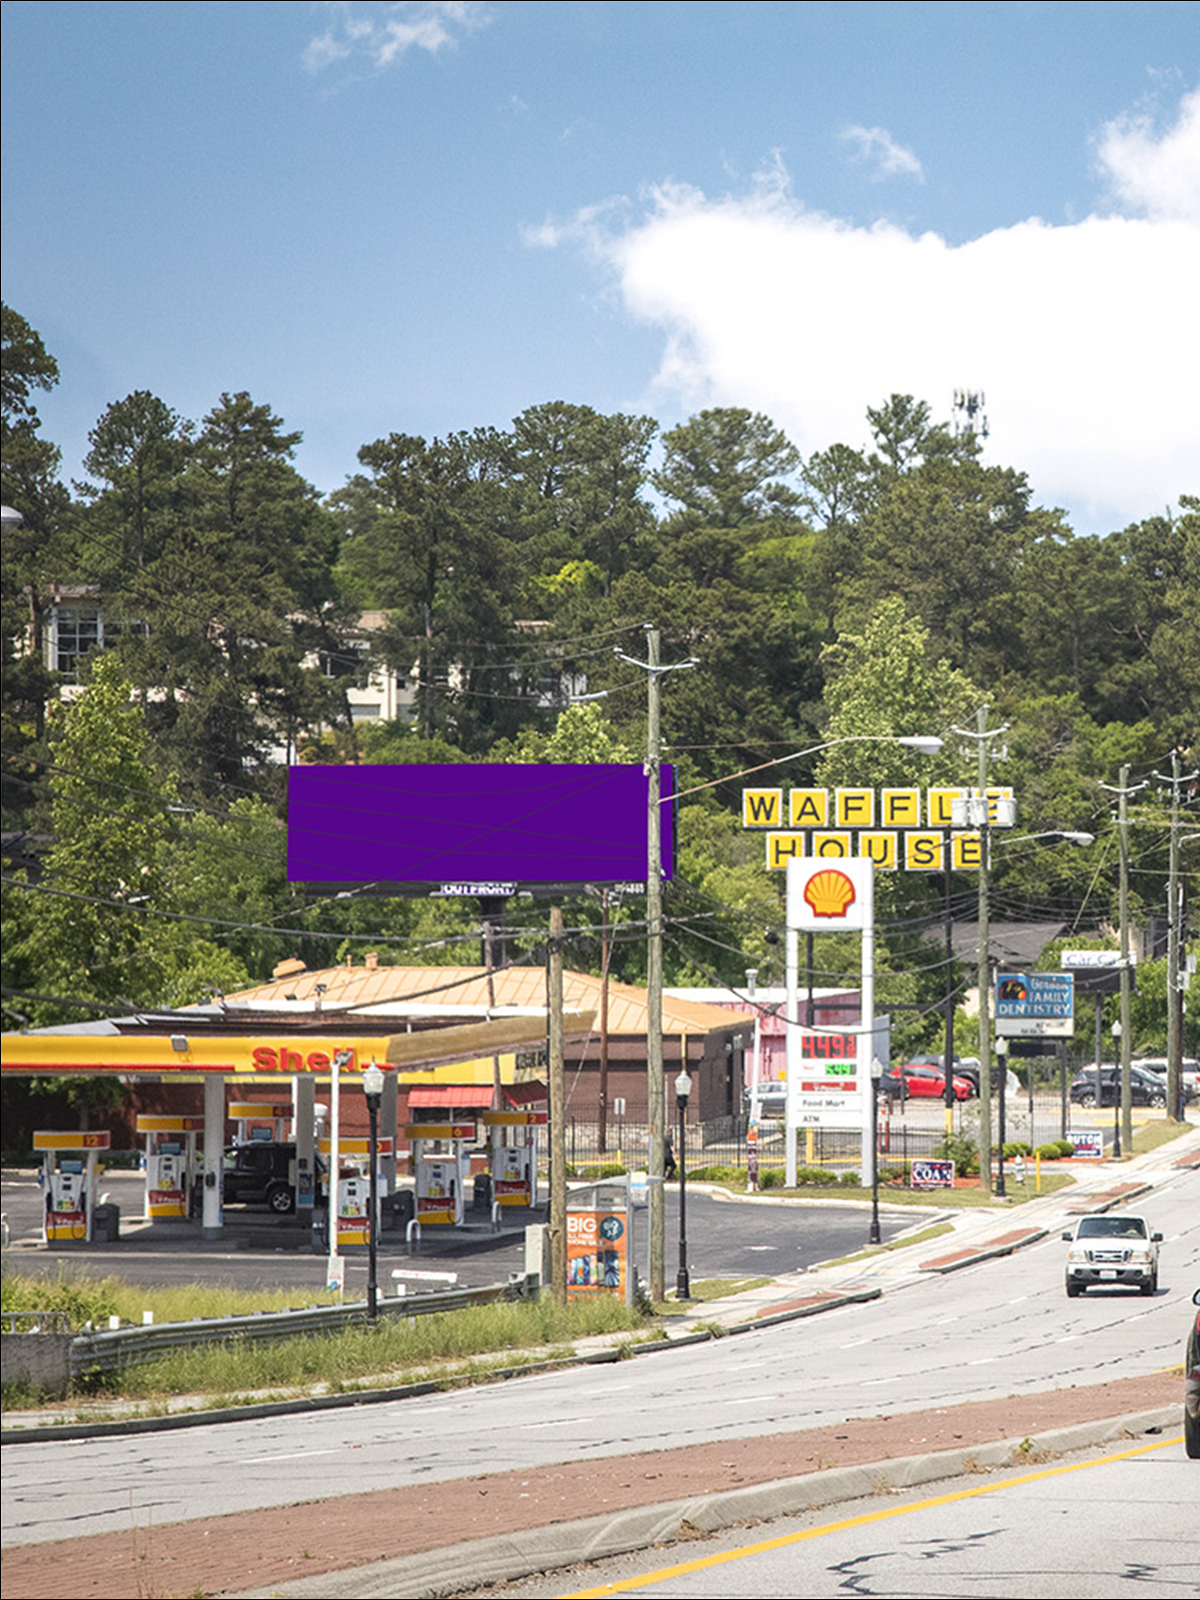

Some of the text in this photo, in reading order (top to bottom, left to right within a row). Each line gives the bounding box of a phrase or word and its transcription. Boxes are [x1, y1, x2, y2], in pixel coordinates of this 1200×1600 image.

[749, 795, 1002, 821] WAFFLE
[775, 838, 981, 865] HOUSE
[1028, 991, 1070, 1003] FAMILY
[999, 1003, 1070, 1015] DENTISTRY
[803, 1099, 846, 1107] Food Mart
[530, 1114, 537, 1124] 2
[803, 1115, 820, 1123] ATM
[453, 1127, 462, 1137] 6
[86, 1135, 99, 1147] 12
[567, 1217, 597, 1233] BIG
